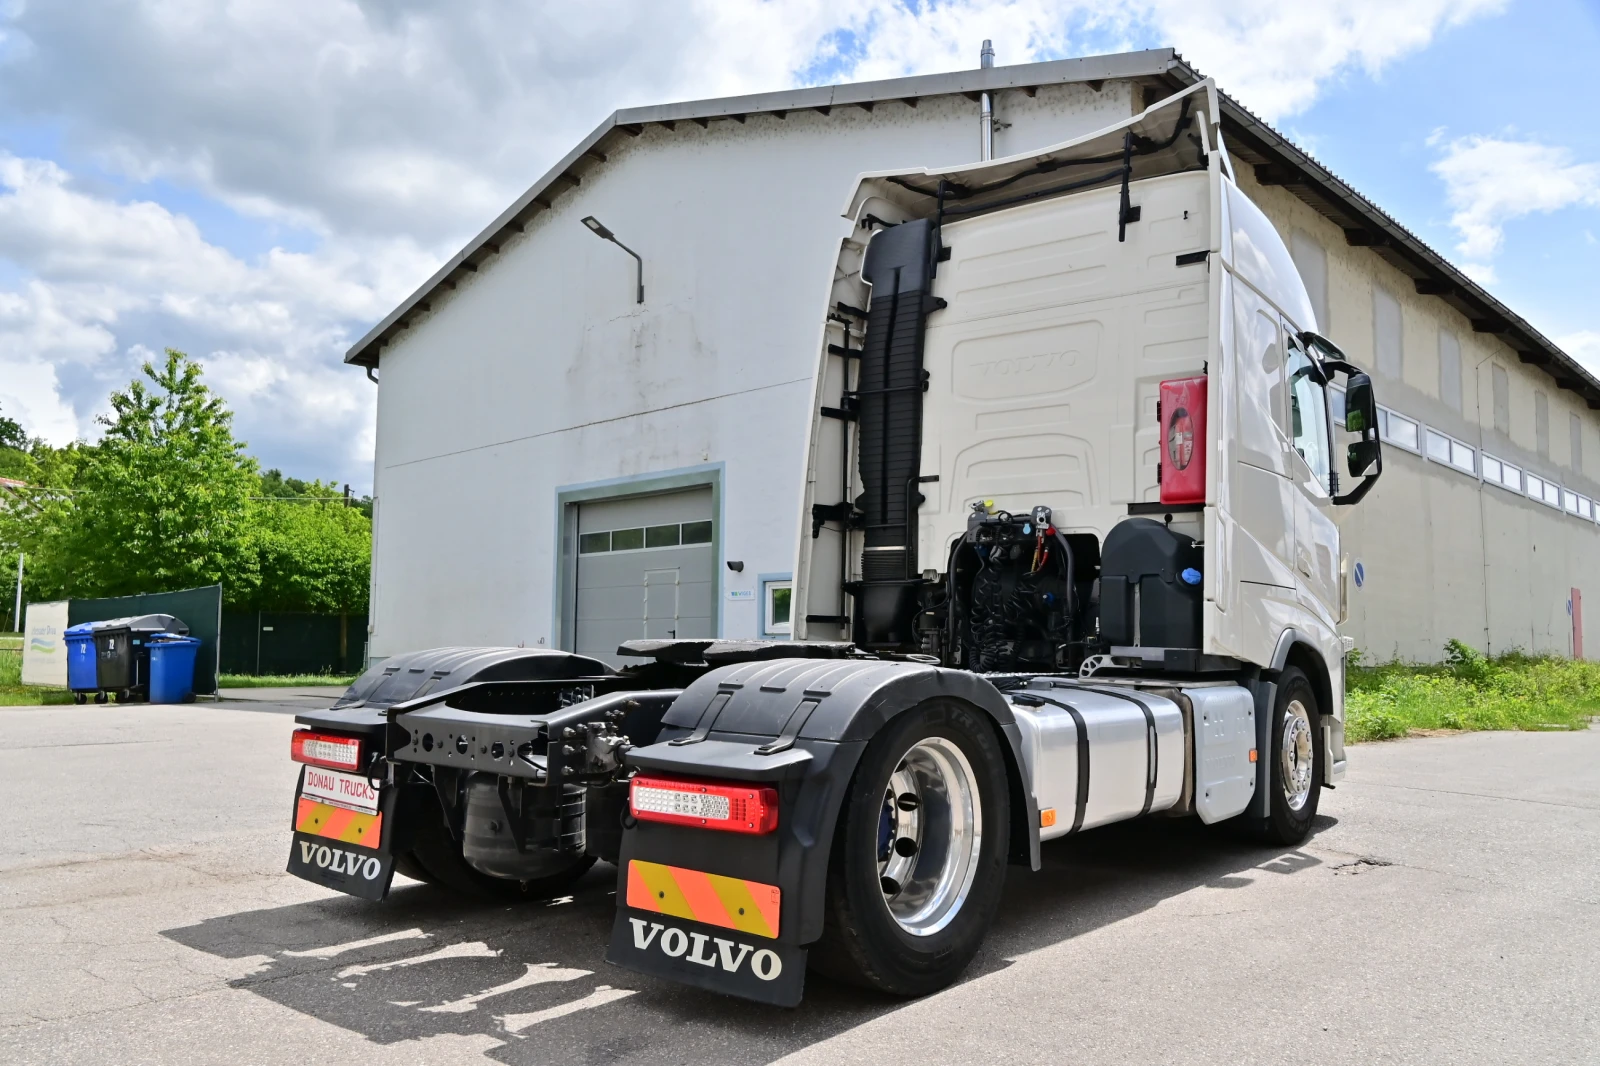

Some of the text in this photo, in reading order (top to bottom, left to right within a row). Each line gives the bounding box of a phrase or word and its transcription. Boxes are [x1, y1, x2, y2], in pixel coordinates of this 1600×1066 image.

[307, 771, 375, 801] DONAU TRUCKS
[299, 841, 381, 880] VOLVO
[629, 917, 782, 981] VOLVO
